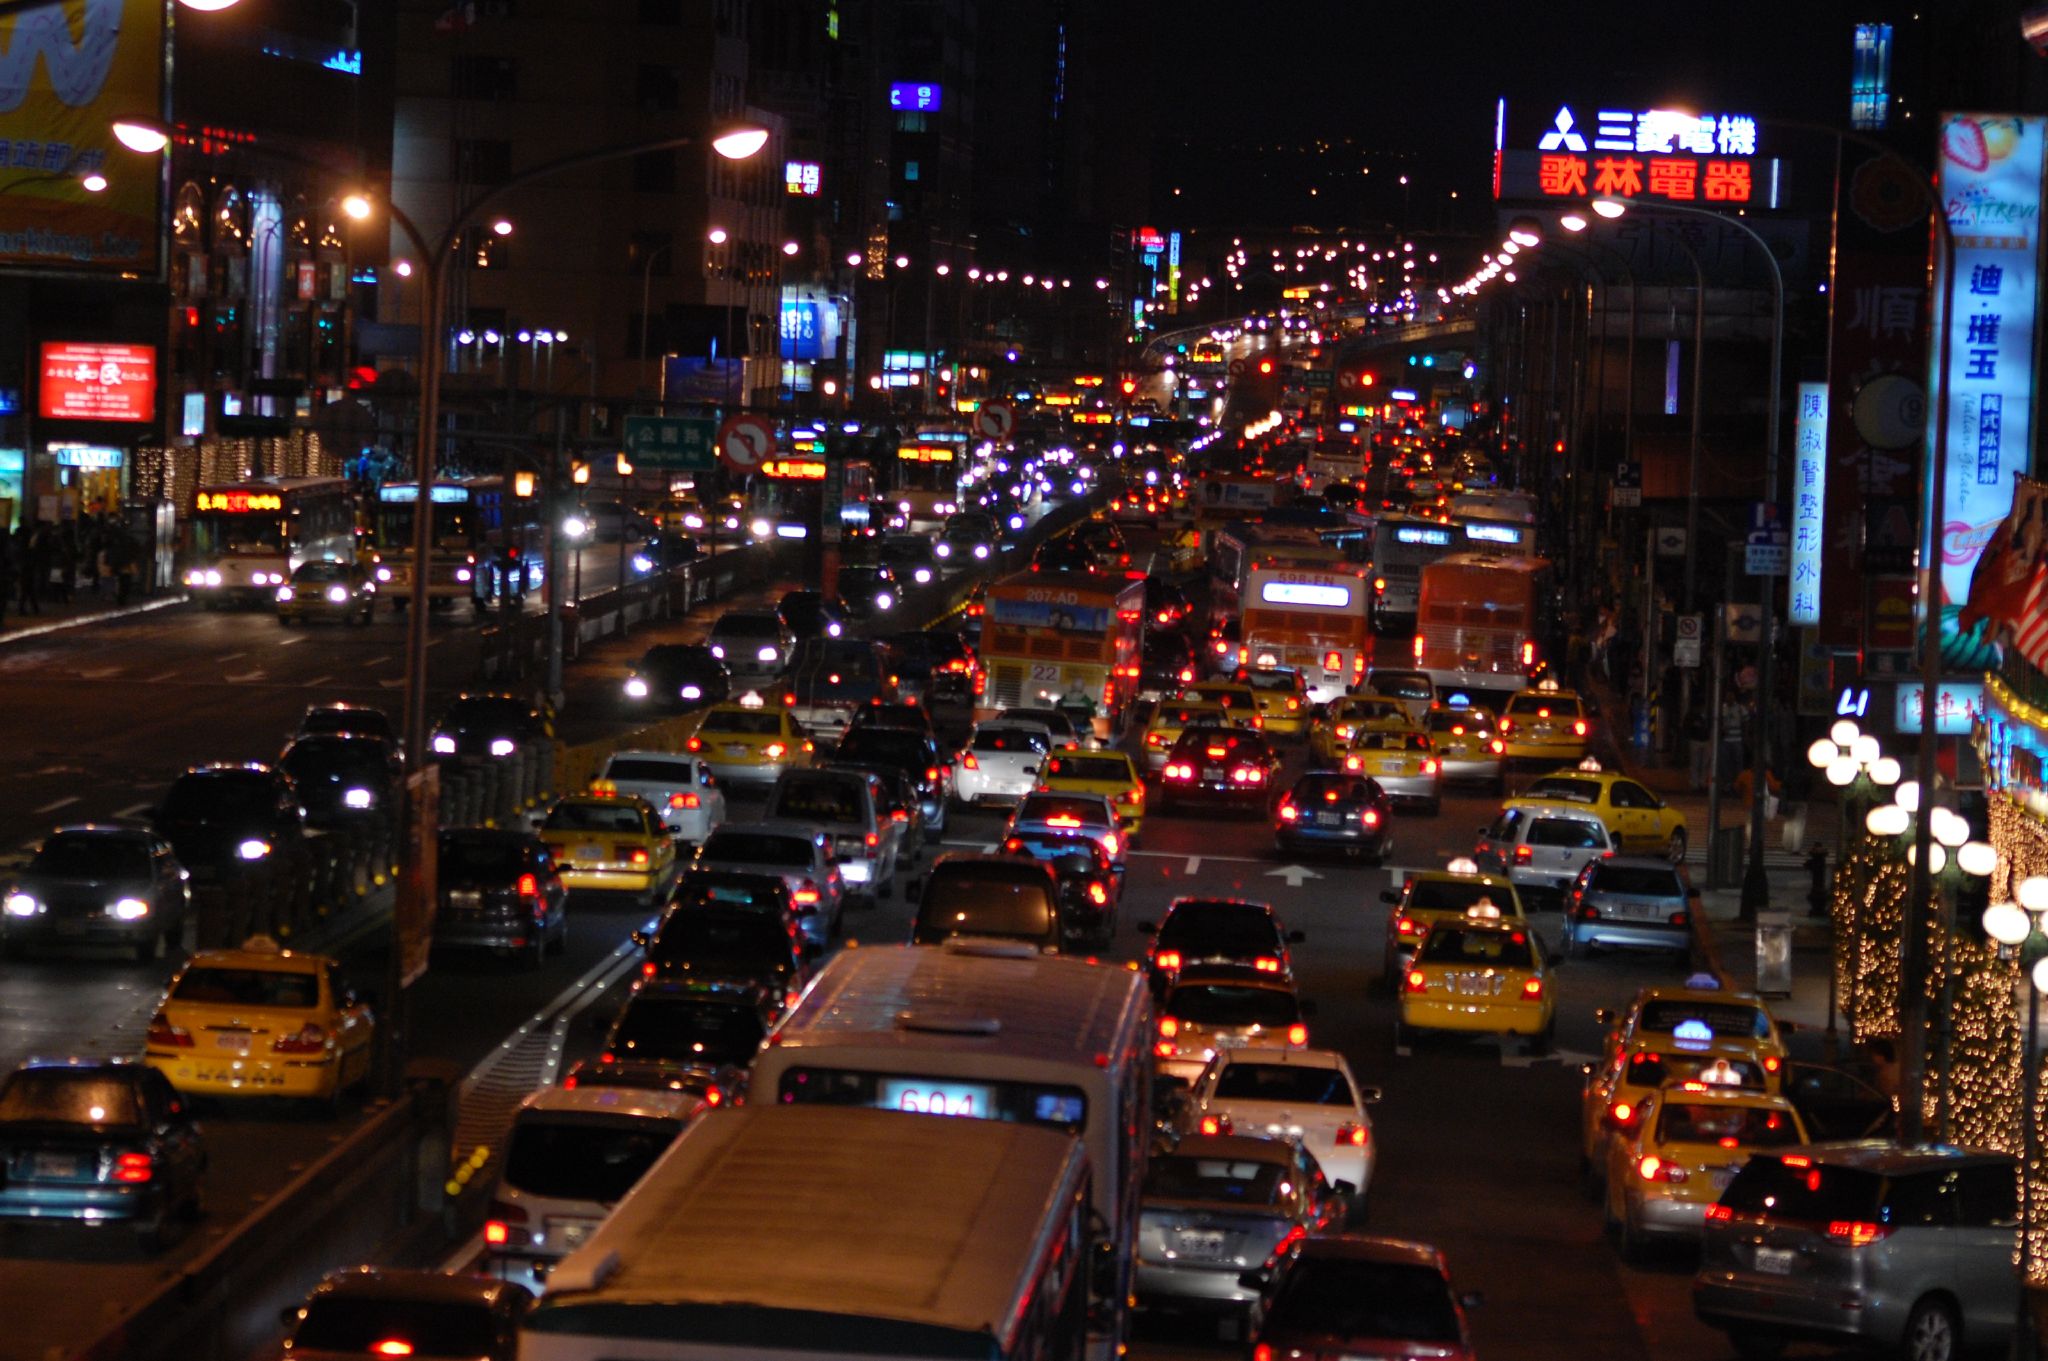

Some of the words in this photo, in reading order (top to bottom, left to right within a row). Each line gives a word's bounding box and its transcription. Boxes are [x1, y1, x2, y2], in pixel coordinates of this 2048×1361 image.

[1539, 153, 1751, 201] 歌林電器
[1792, 393, 1823, 619] 陳淑賢整形外科
[1025, 588, 1079, 606] 207-AD
[1033, 665, 1057, 681] 22
